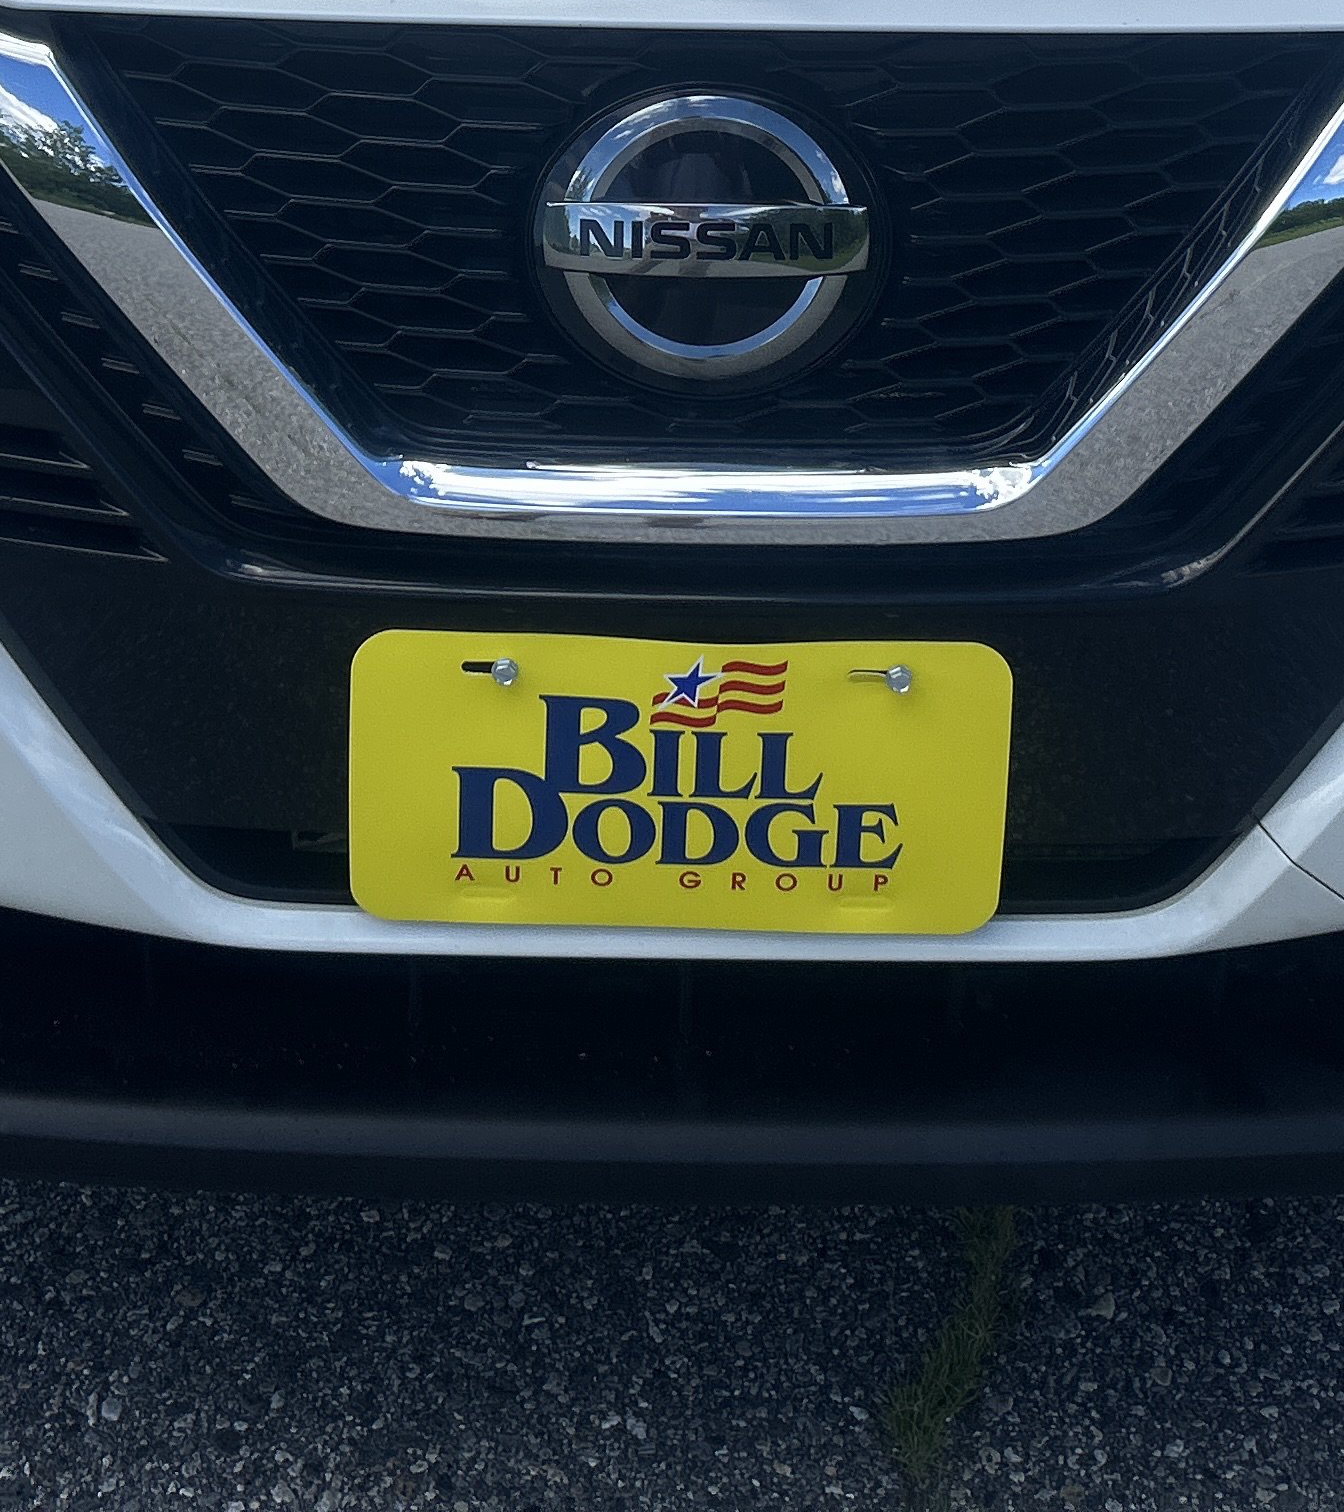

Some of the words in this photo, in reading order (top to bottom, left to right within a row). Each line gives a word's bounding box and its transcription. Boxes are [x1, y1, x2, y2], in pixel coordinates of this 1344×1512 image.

[579, 218, 834, 261] NISSAN
[539, 694, 823, 800] BILL
[451, 766, 903, 870] DODGE
[455, 864, 613, 887] AUTO
[678, 871, 889, 893] GROUP
